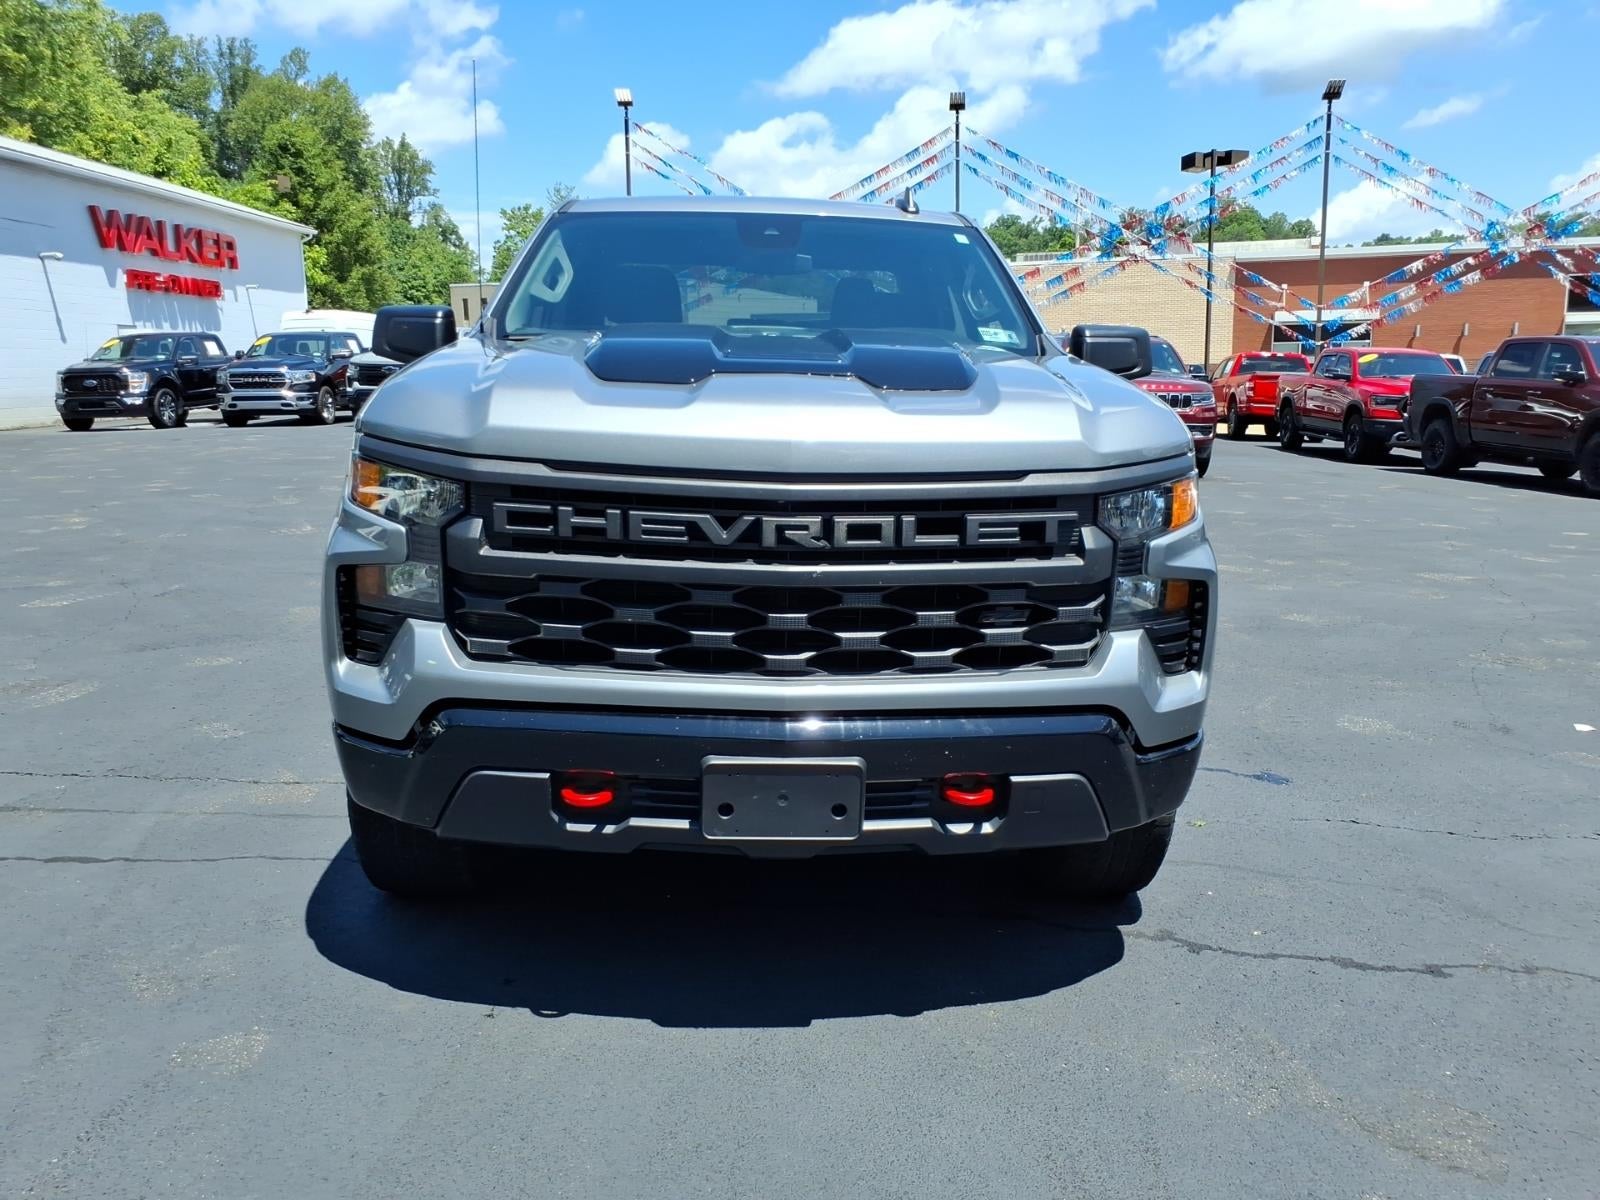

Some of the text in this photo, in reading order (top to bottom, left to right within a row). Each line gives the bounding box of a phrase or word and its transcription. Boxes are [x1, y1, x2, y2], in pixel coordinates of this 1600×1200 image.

[87, 204, 240, 270] WALKER
[125, 269, 224, 298] PRE-OWNED
[492, 502, 1079, 549] CHEVROLET
